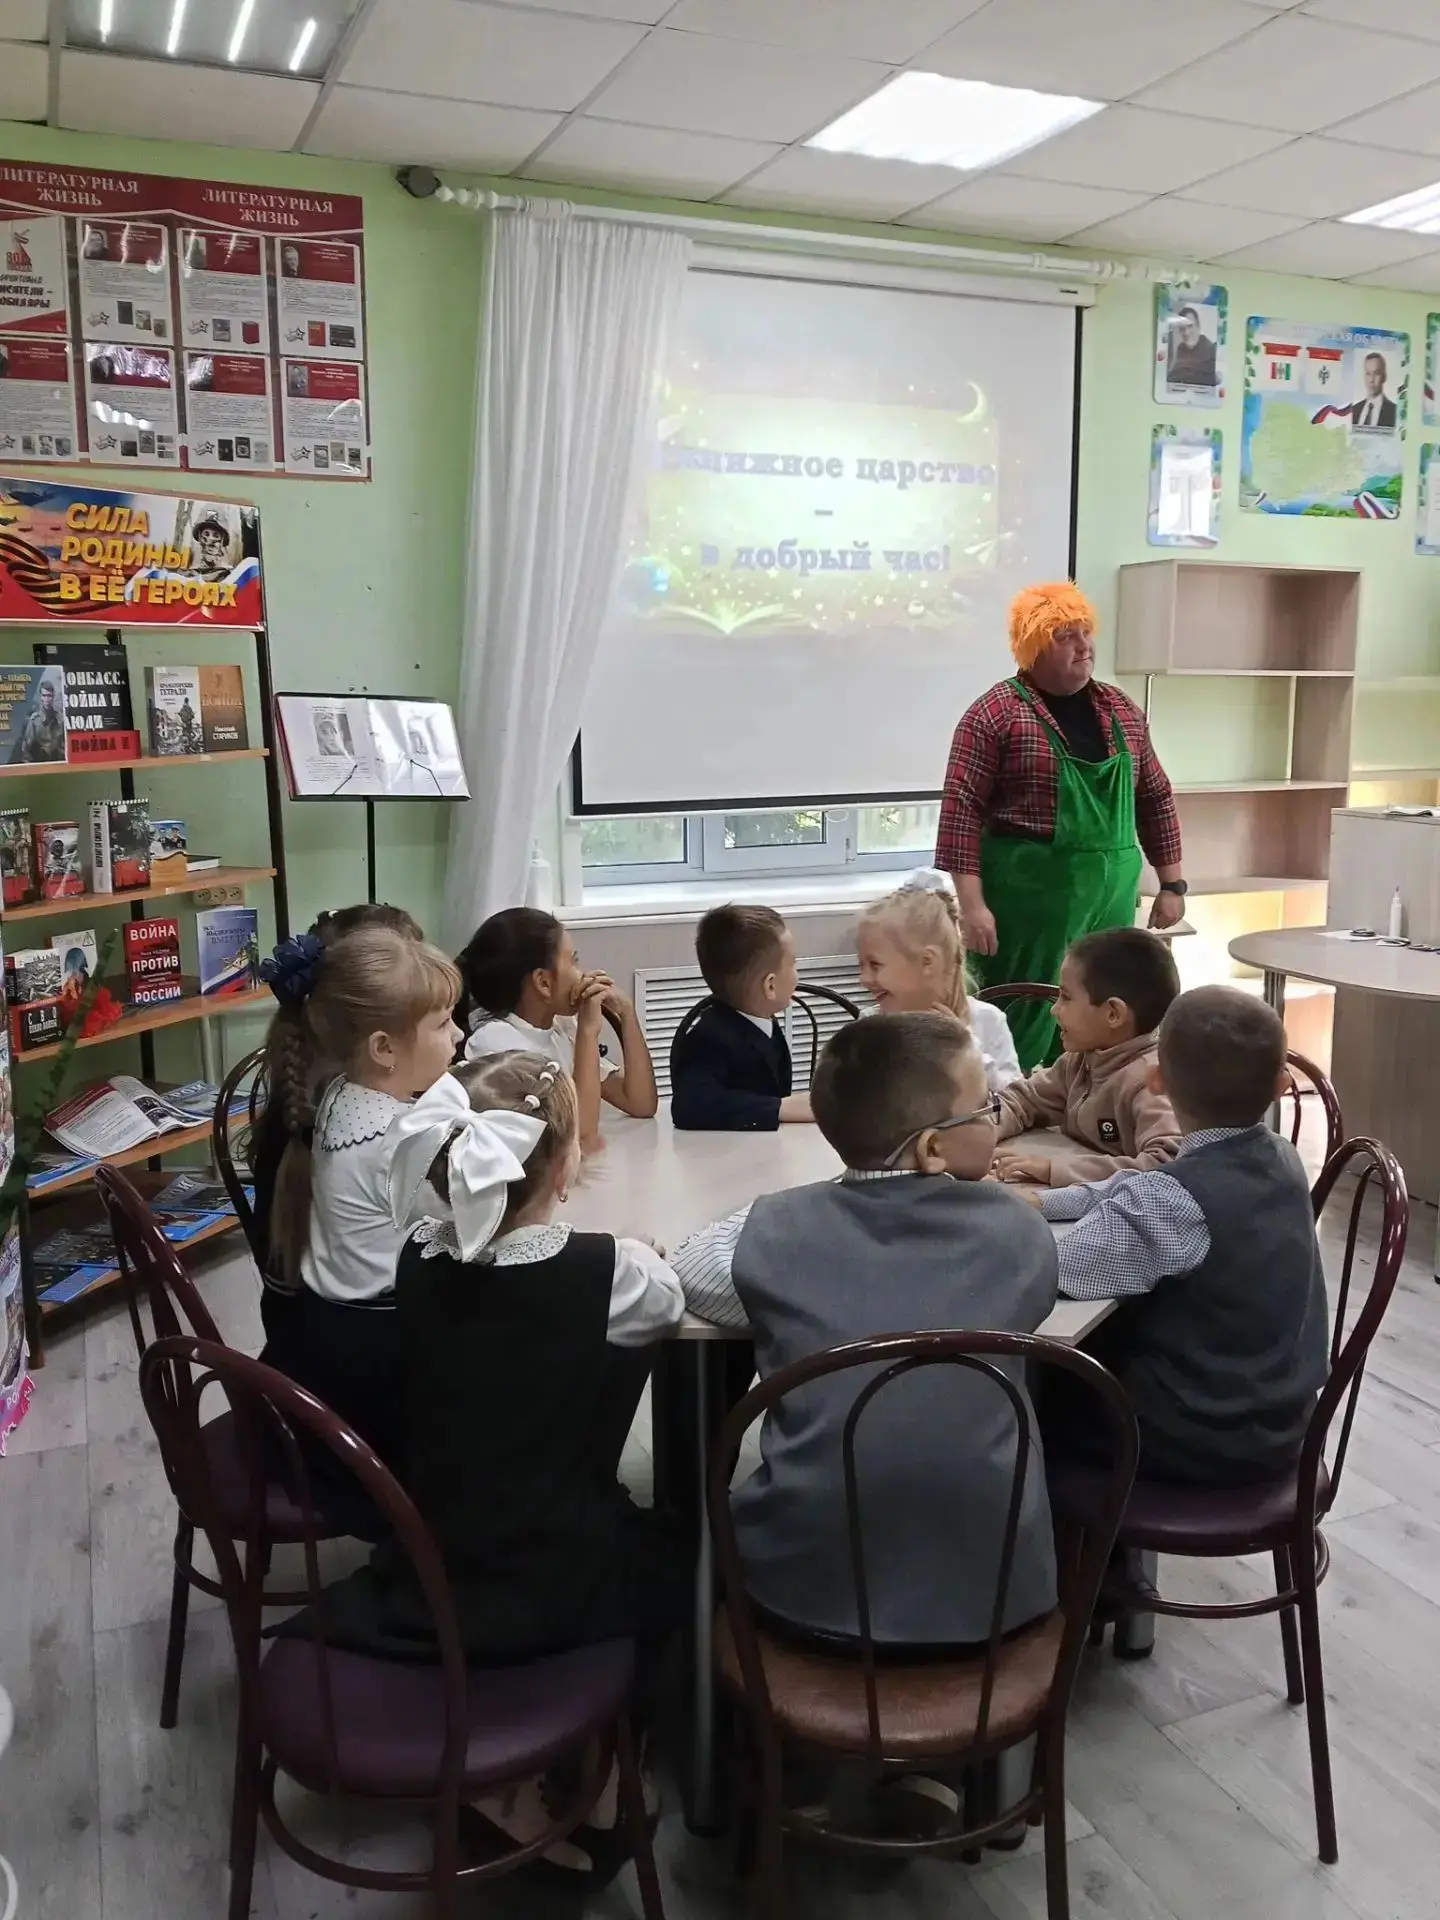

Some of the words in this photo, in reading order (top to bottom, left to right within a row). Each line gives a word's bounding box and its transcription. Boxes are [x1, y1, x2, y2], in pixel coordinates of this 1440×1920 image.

[36, 187, 102, 206] ЖИЗНЬ
[202, 188, 333, 214] ЛИТЕРАТУРНАЯ
[240, 208, 300, 226] ЖИЗНЬ
[855, 457, 996, 490] царство
[66, 503, 149, 535] СИЛА
[60, 536, 194, 570] РОДИНЫ
[731, 538, 873, 577] добрый
[883, 545, 951, 572] час!
[60, 573, 83, 600] В
[90, 569, 125, 602] ЕЁ
[132, 577, 237, 607] ГЕРОЯХ
[110, 693, 120, 707] И
[71, 735, 117, 753] ВОЙНА
[130, 924, 176, 941] ВОЙНА
[132, 955, 178, 973] ПРОТИВ
[134, 985, 181, 1003] РОССИИ
